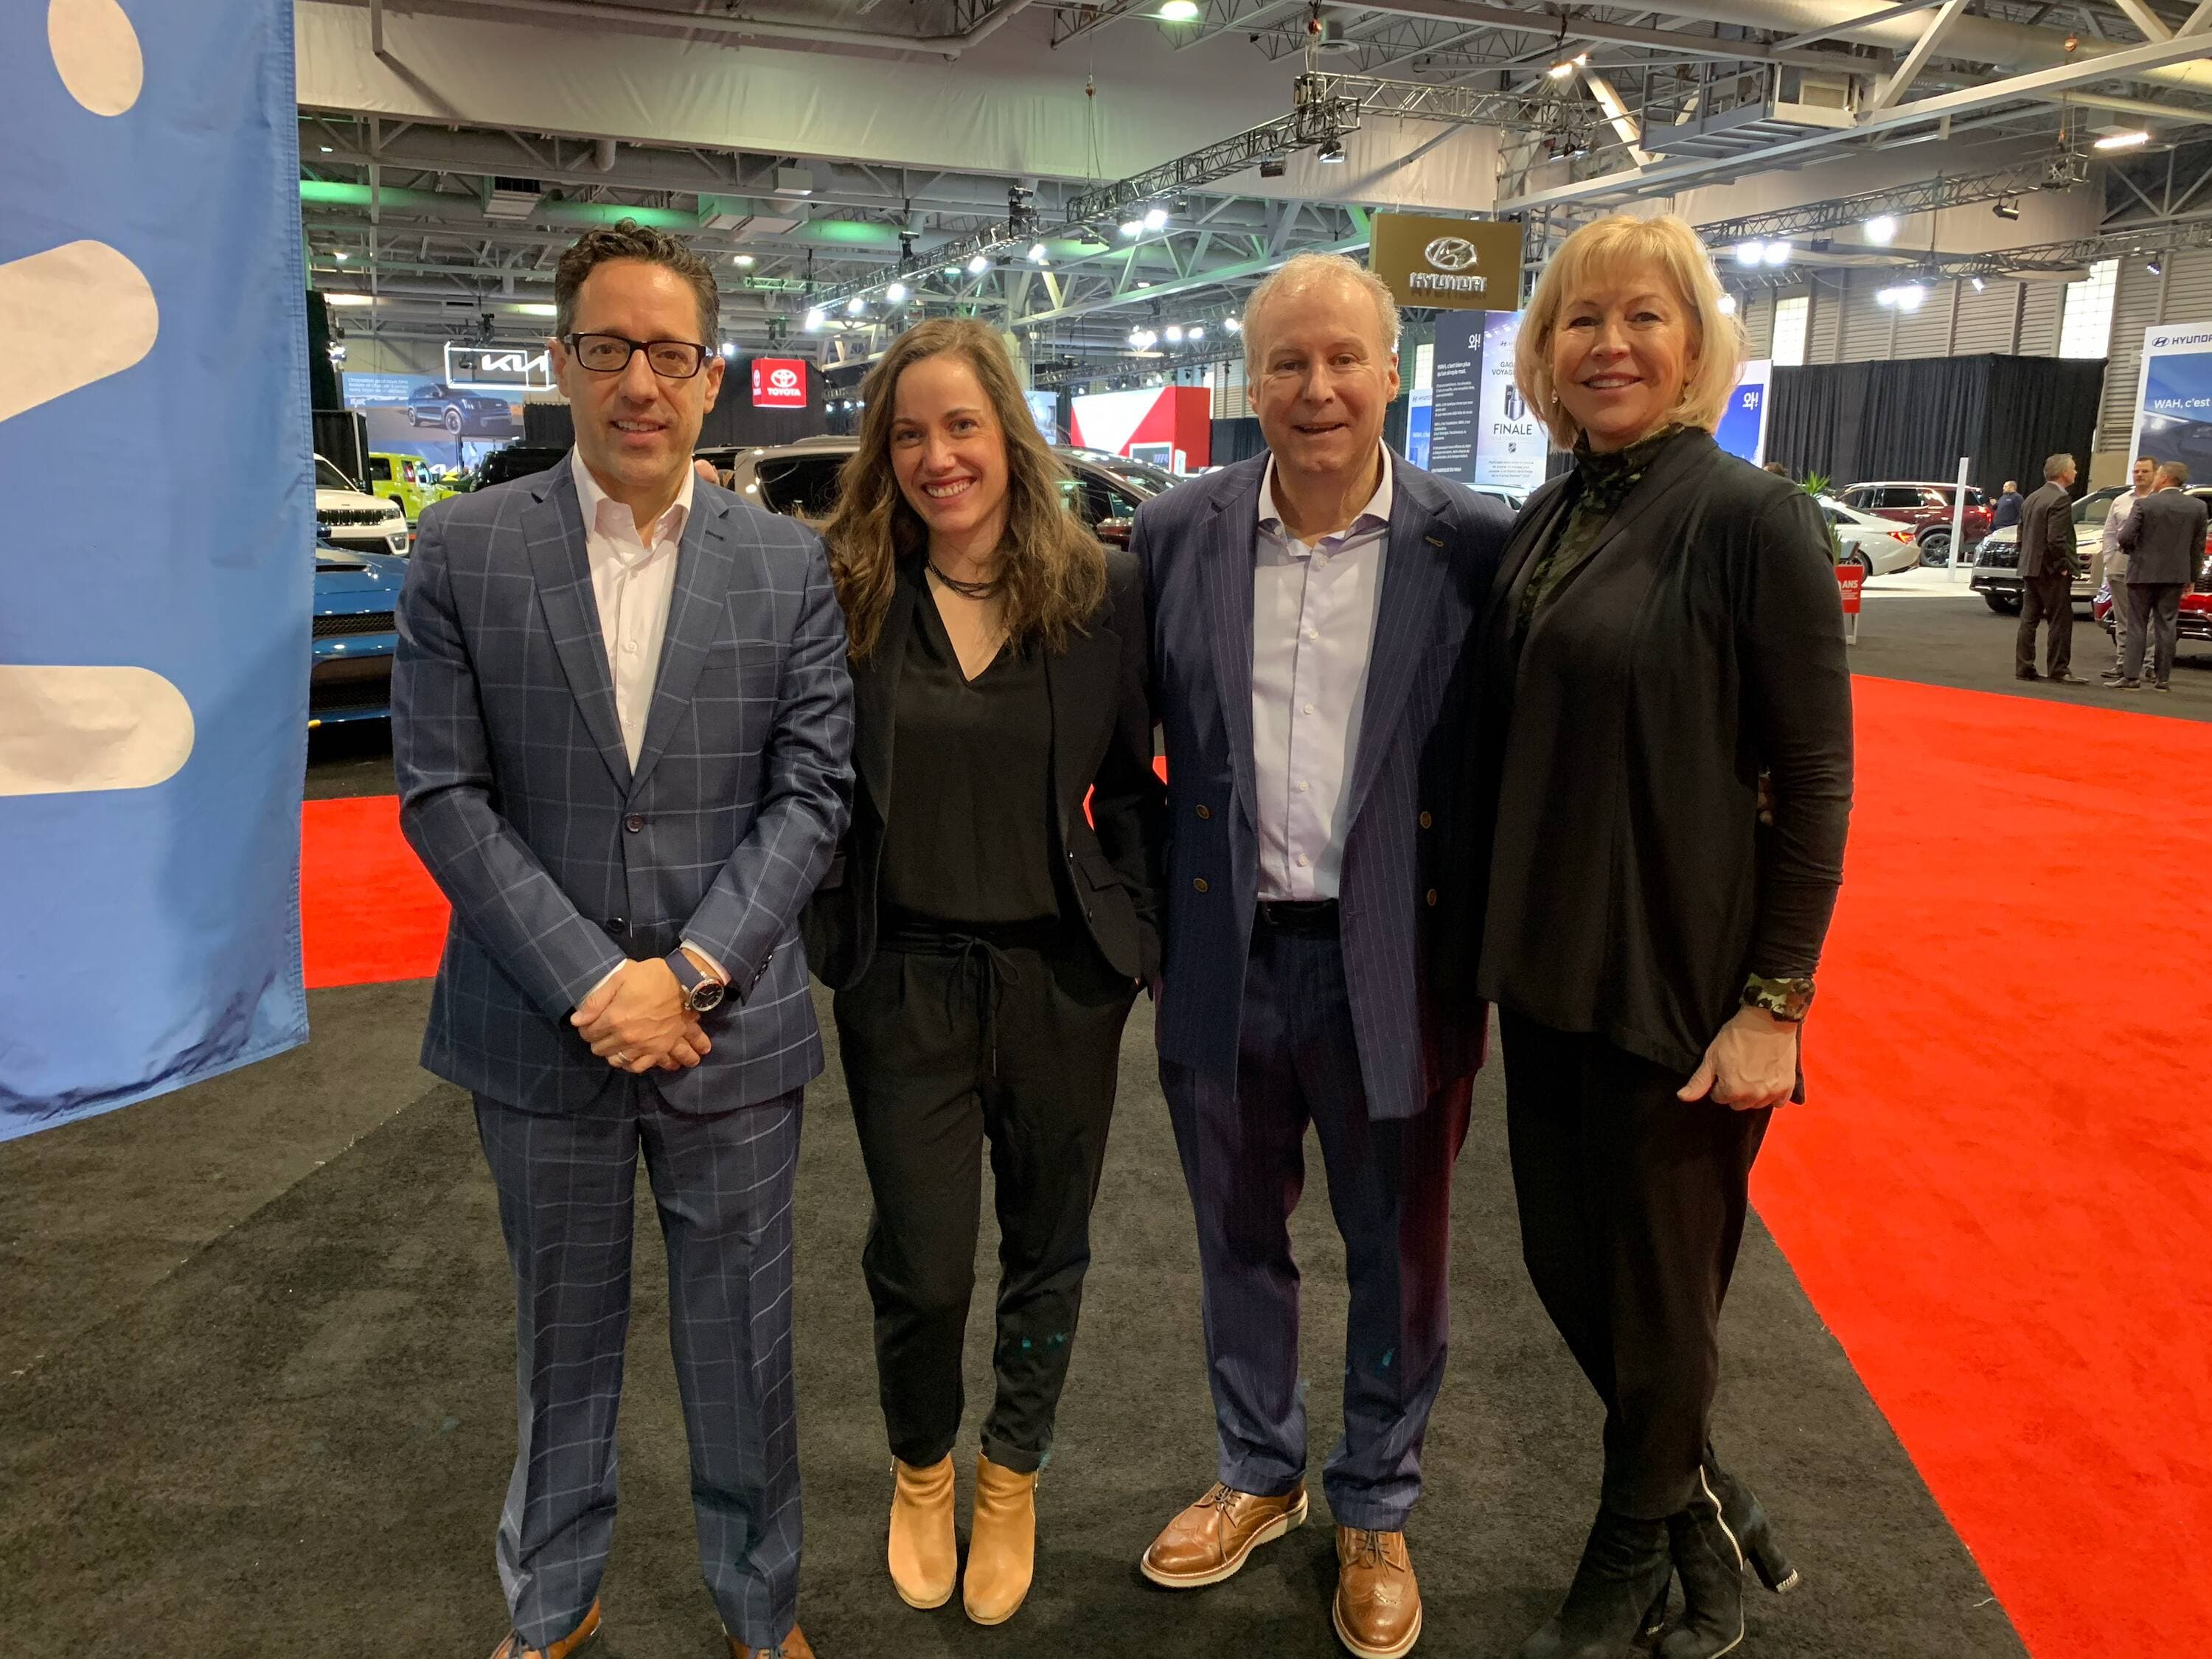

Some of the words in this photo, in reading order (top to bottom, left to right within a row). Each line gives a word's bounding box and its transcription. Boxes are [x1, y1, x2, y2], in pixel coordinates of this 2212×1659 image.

[1410, 272, 1487, 292] HYUNDAI
[1468, 333, 1481, 351] 와!
[767, 388, 801, 397] TOYOTA
[1742, 392, 1759, 411] 와!
[2154, 399, 2183, 409] WAH,
[2185, 398, 2211, 408] c'est
[1493, 423, 1533, 435] FINALE
